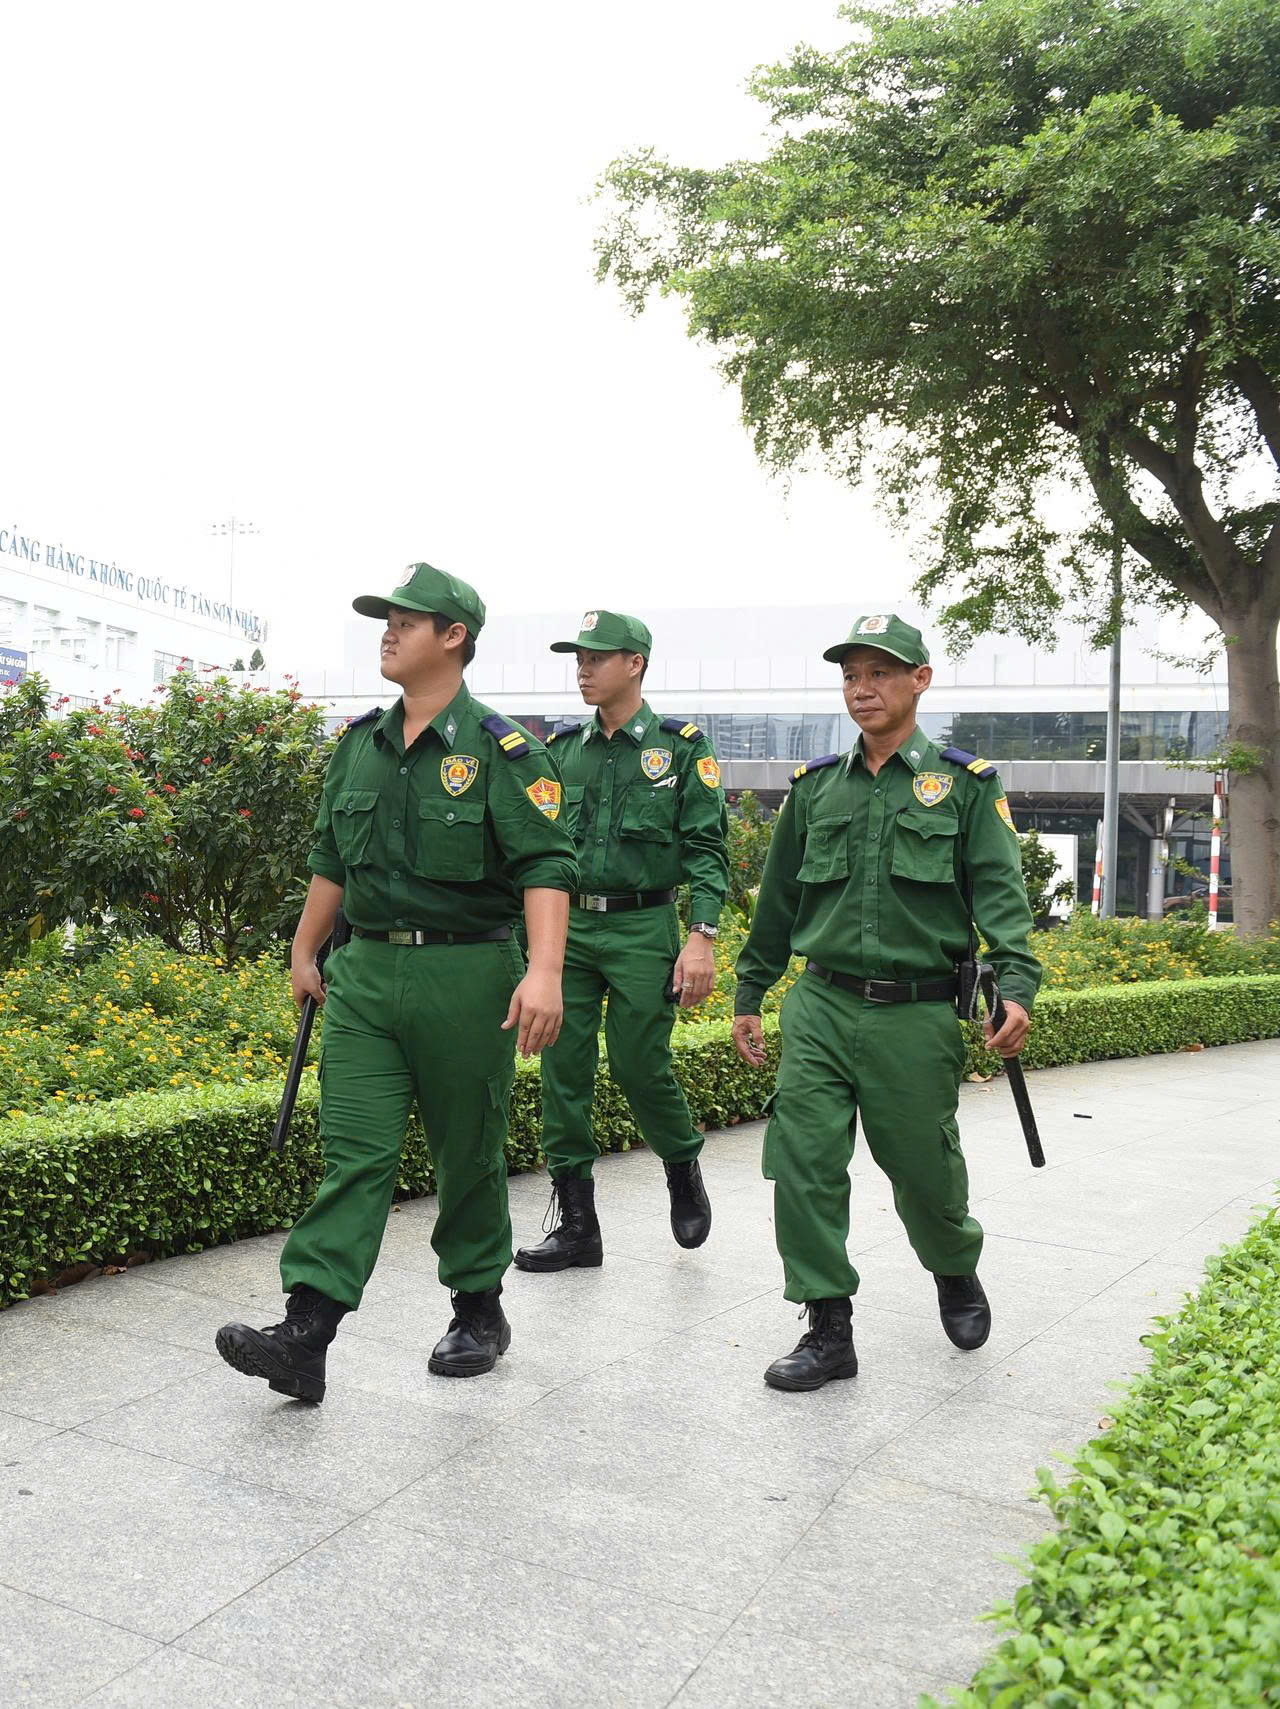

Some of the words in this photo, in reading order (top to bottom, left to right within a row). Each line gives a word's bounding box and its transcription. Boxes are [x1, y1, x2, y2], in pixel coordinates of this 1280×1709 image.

[46, 543, 85, 576] HÀNG
[89, 560, 133, 592] KHÔNG
[137, 576, 169, 604] QUỐC
[173, 585, 187, 609] TẾ
[191, 592, 211, 618] TÂN
[213, 602, 233, 625] SƠN
